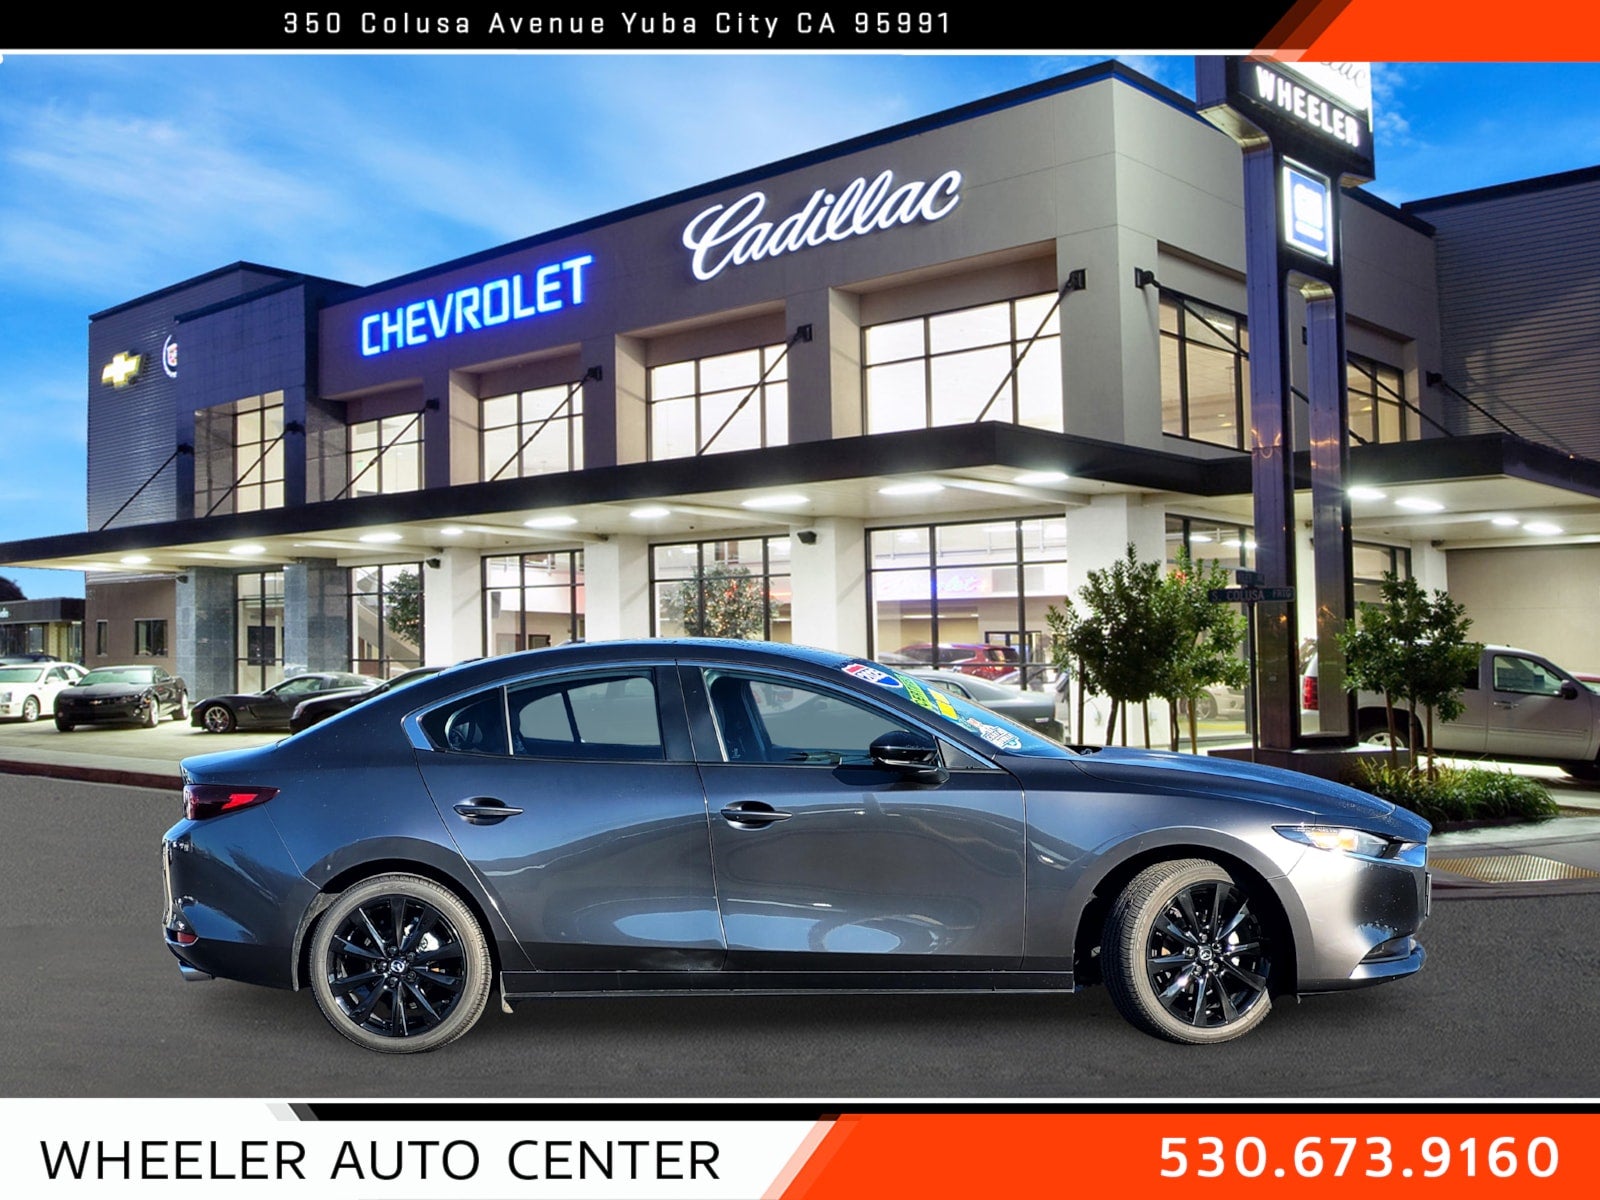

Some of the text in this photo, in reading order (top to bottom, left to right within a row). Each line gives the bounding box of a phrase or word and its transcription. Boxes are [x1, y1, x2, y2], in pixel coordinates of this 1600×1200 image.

[1254, 64, 1360, 148] WHEELER
[682, 169, 962, 281] Cadillac
[361, 254, 594, 357] CHEVROLET
[1226, 589, 1265, 602] COLUSA
